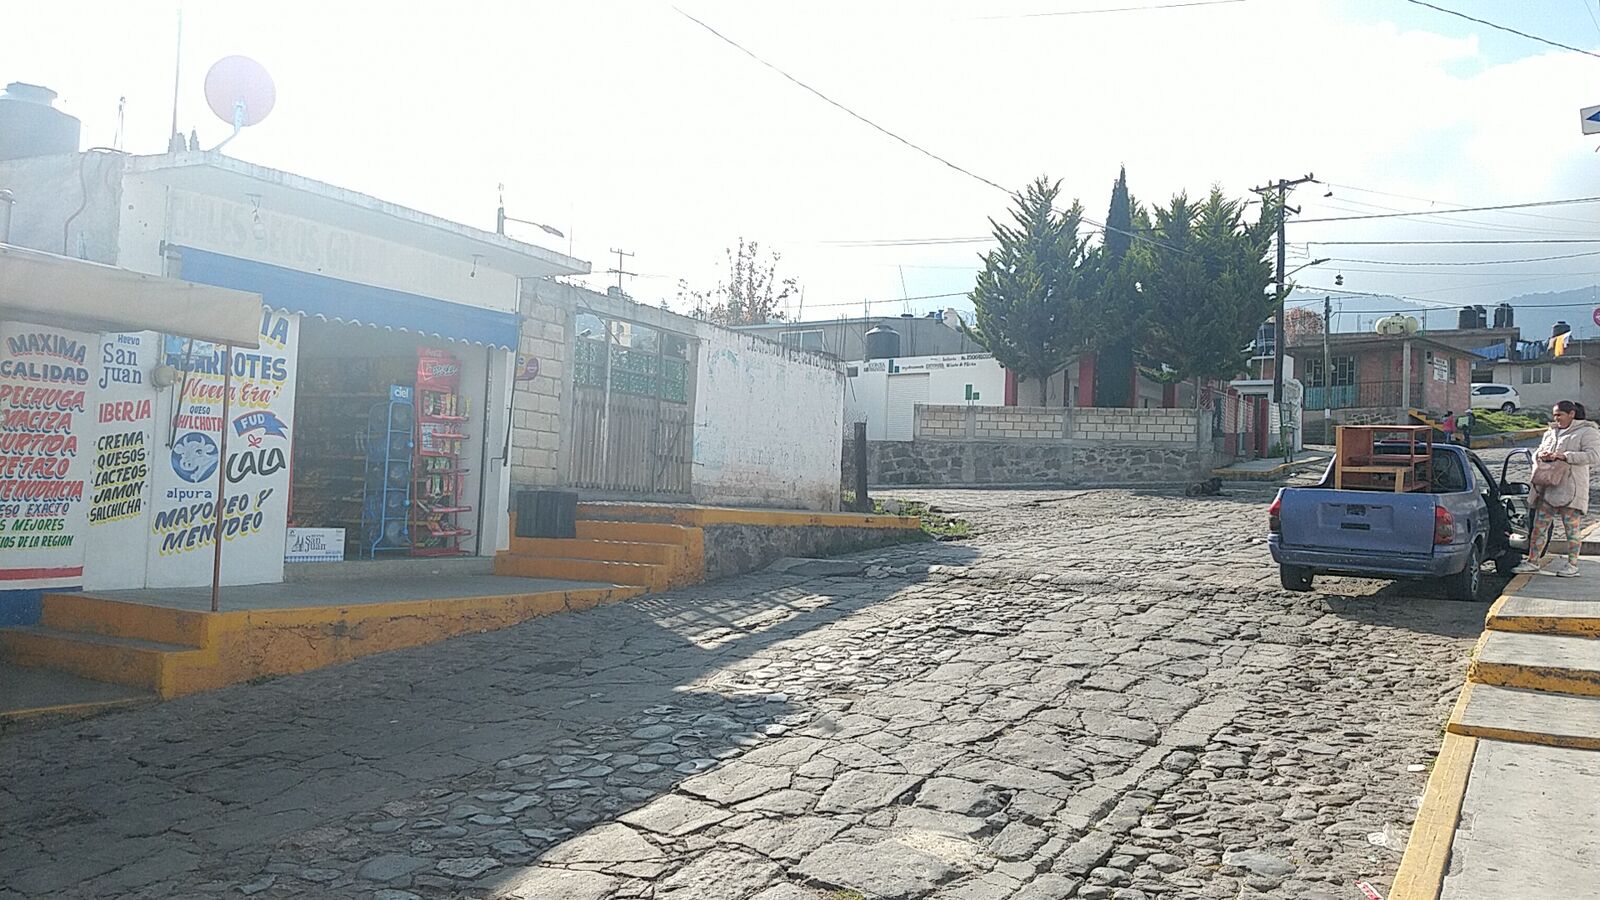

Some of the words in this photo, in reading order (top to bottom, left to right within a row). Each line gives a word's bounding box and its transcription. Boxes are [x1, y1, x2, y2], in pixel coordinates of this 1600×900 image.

[7, 333, 87, 363] MAXIMA
[103, 342, 138, 367] San
[0, 360, 89, 382] CALIDAD
[98, 366, 143, 389] Juan
[0, 384, 85, 410] PECHUGA
[181, 377, 236, 401] Nueva
[393, 385, 410, 399] ciel
[98, 400, 151, 423] IBERIA
[189, 405, 211, 415] QUESO
[240, 413, 265, 430] FUD
[0, 433, 77, 455] URTIDA
[98, 431, 144, 451] CREMA
[96, 447, 146, 469] QUESOS
[226, 447, 287, 484] LALA
[94, 463, 147, 487] LACTEOS
[93, 481, 143, 504] JAMON
[166, 488, 213, 503] alpura
[257, 487, 274, 508] Y
[26, 501, 70, 516] EXACTO
[89, 499, 141, 523] SALCHICHA
[11, 518, 65, 531] MEJORES
[18, 536, 29, 548] DE
[29, 536, 39, 548] LA
[41, 534, 74, 547] REGION
